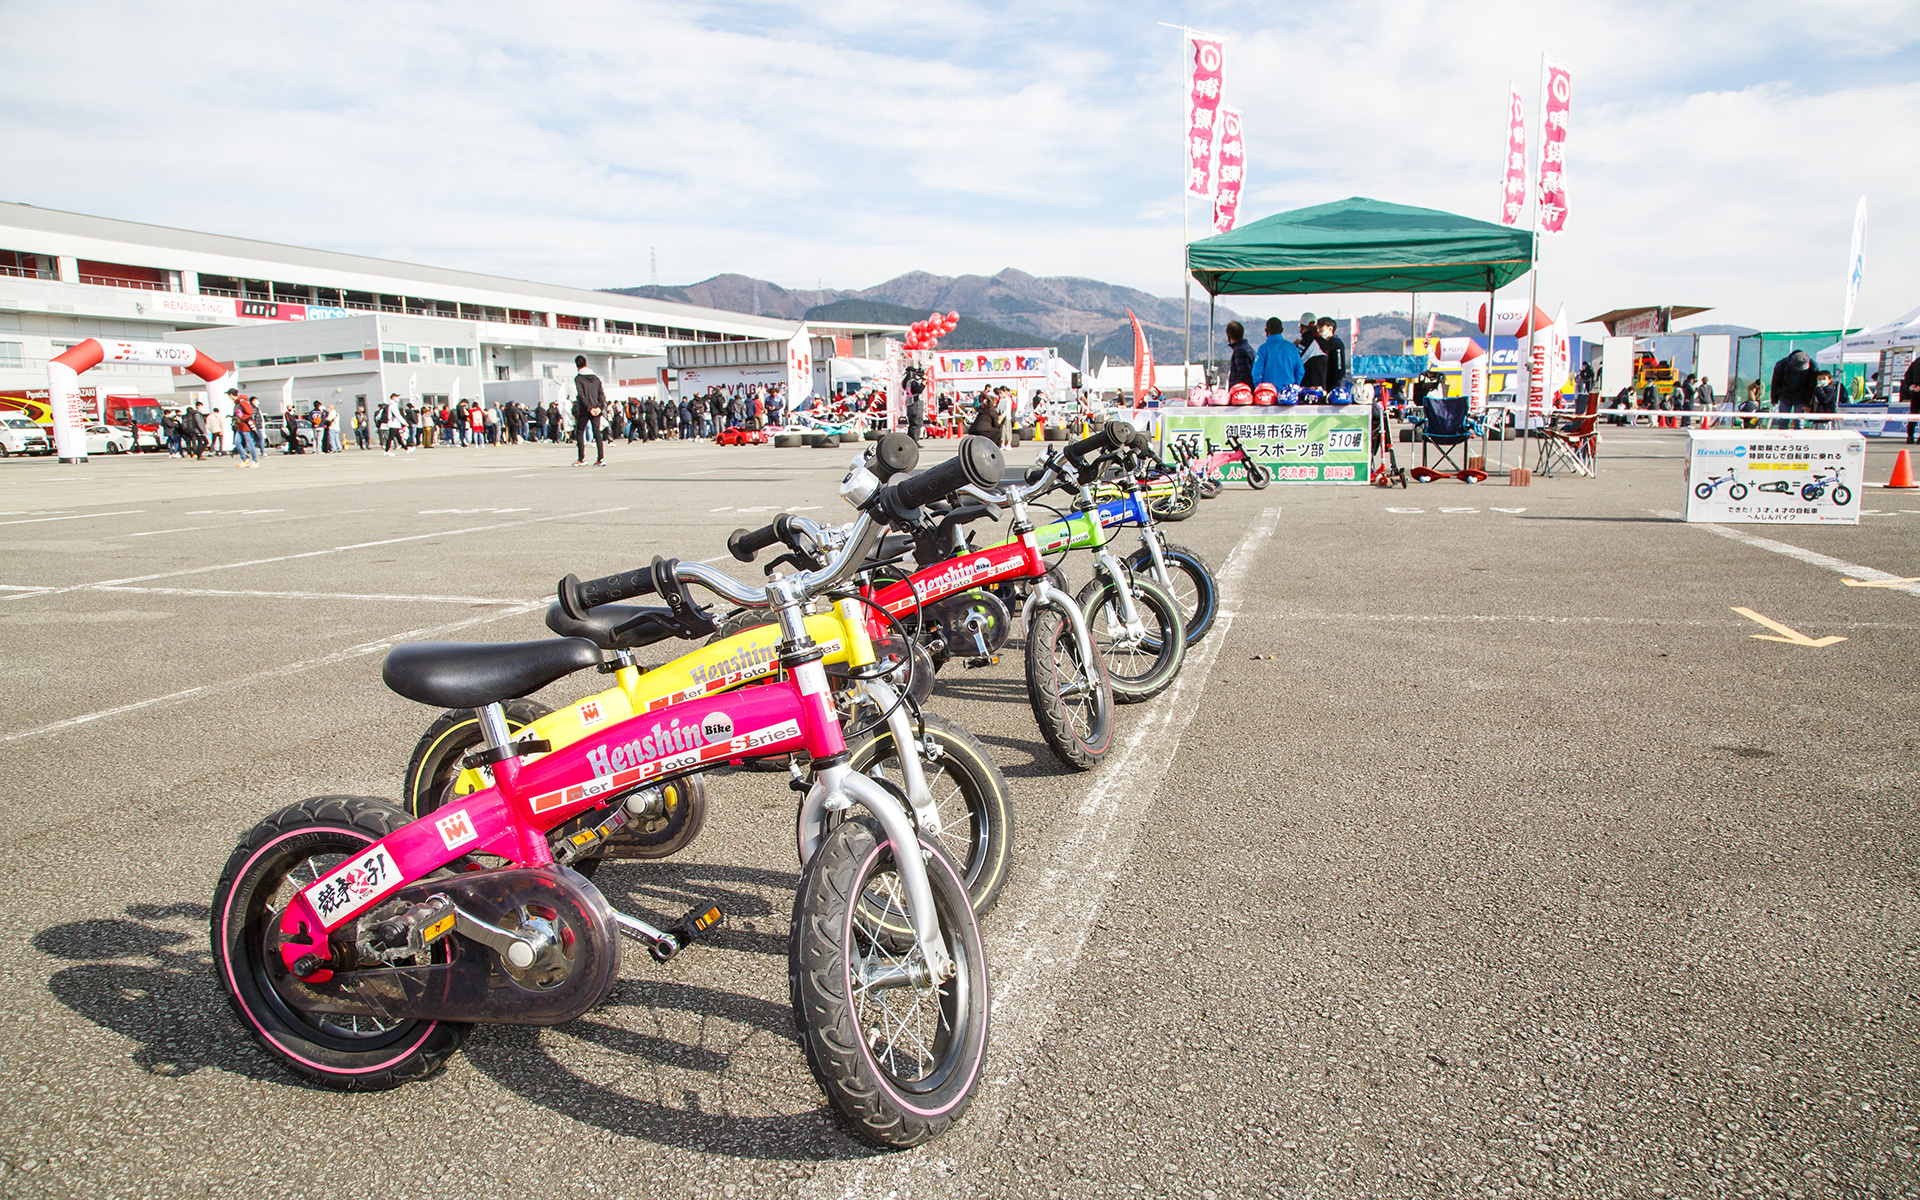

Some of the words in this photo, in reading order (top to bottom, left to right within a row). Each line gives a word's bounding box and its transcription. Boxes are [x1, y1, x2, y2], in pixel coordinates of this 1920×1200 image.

[1225, 424, 1308, 439] 御殿場市役所
[1208, 443, 1325, 458] モーースポーツ部
[689, 641, 776, 686] Henshin
[704, 724, 731, 736] Bike
[586, 718, 704, 779] Henshin
[640, 756, 697, 778] Proto
[730, 725, 799, 753] Series
